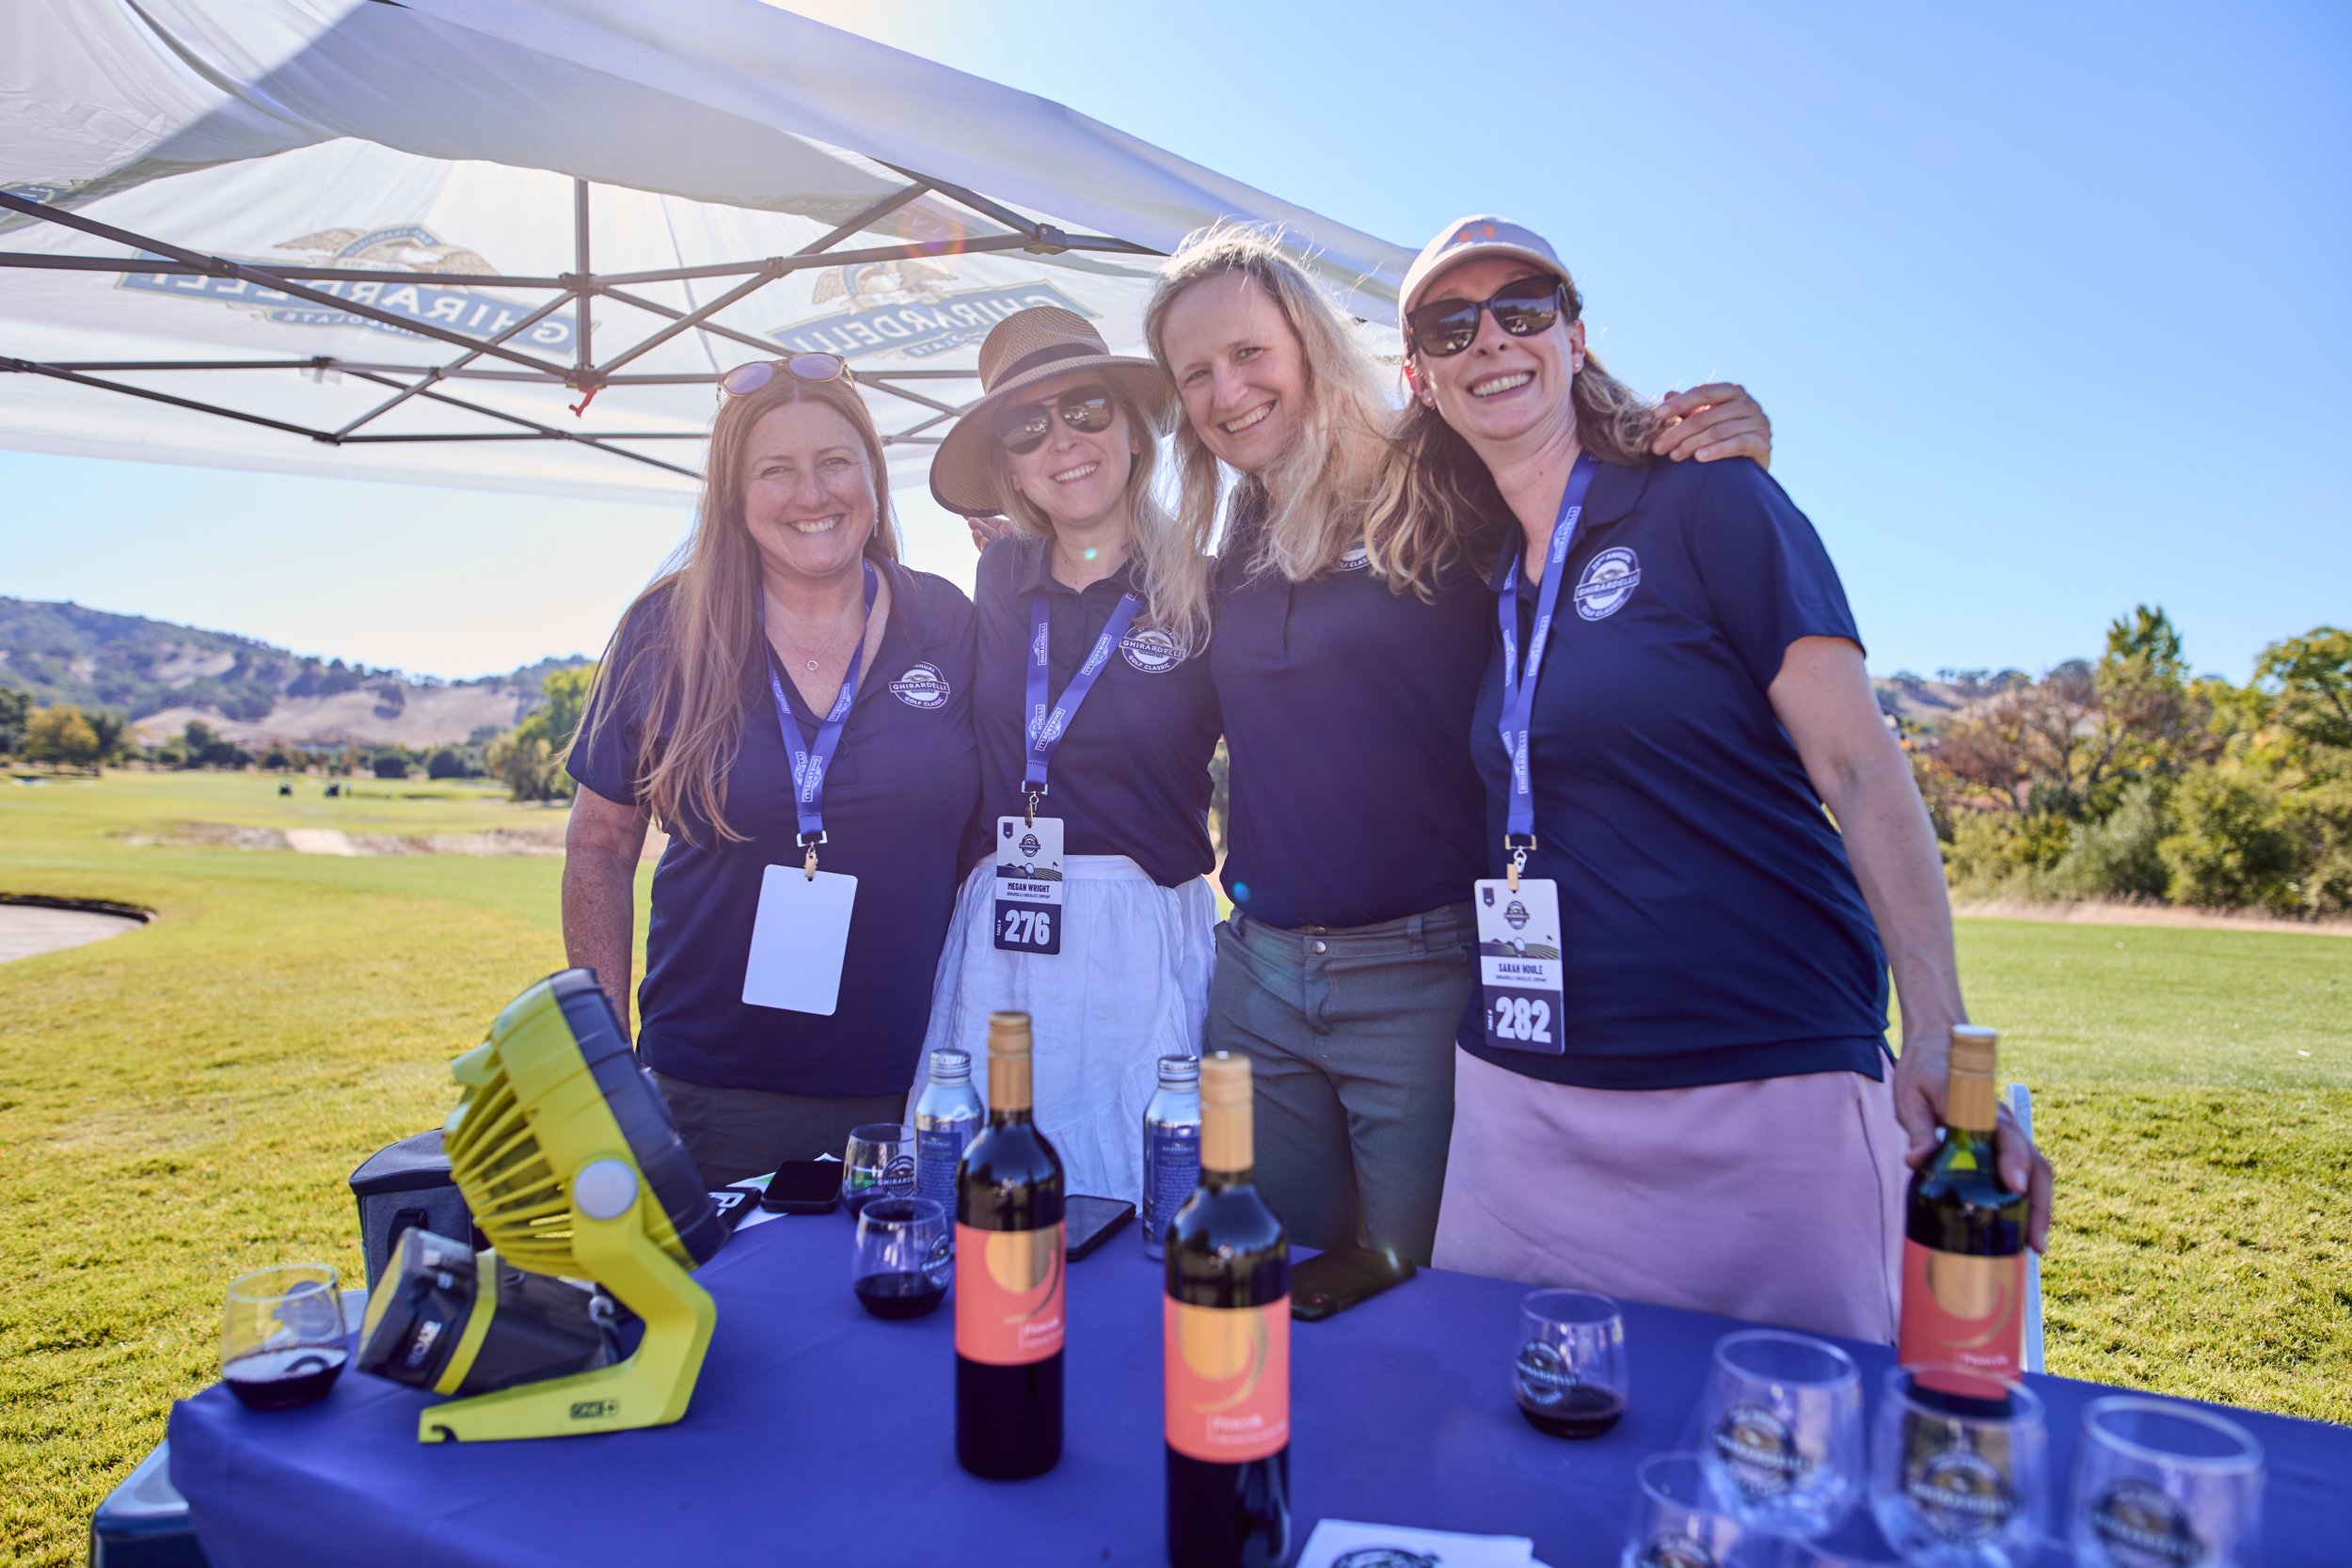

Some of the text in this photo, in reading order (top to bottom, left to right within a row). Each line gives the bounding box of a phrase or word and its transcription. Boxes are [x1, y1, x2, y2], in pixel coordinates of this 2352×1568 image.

[1349, 557, 1371, 568] CLAS
[1122, 640, 1182, 657] GHIRARDELLI
[1128, 655, 1170, 671] GOLF CLASSIC
[892, 682, 946, 691] GHIRARDELLI
[904, 696, 922, 705] GOLF
[1008, 882, 1050, 893] MEGAN WRIGHT
[1004, 909, 1051, 945] 276
[1499, 963, 1520, 974] SARAH
[1496, 996, 1551, 1044] 282
